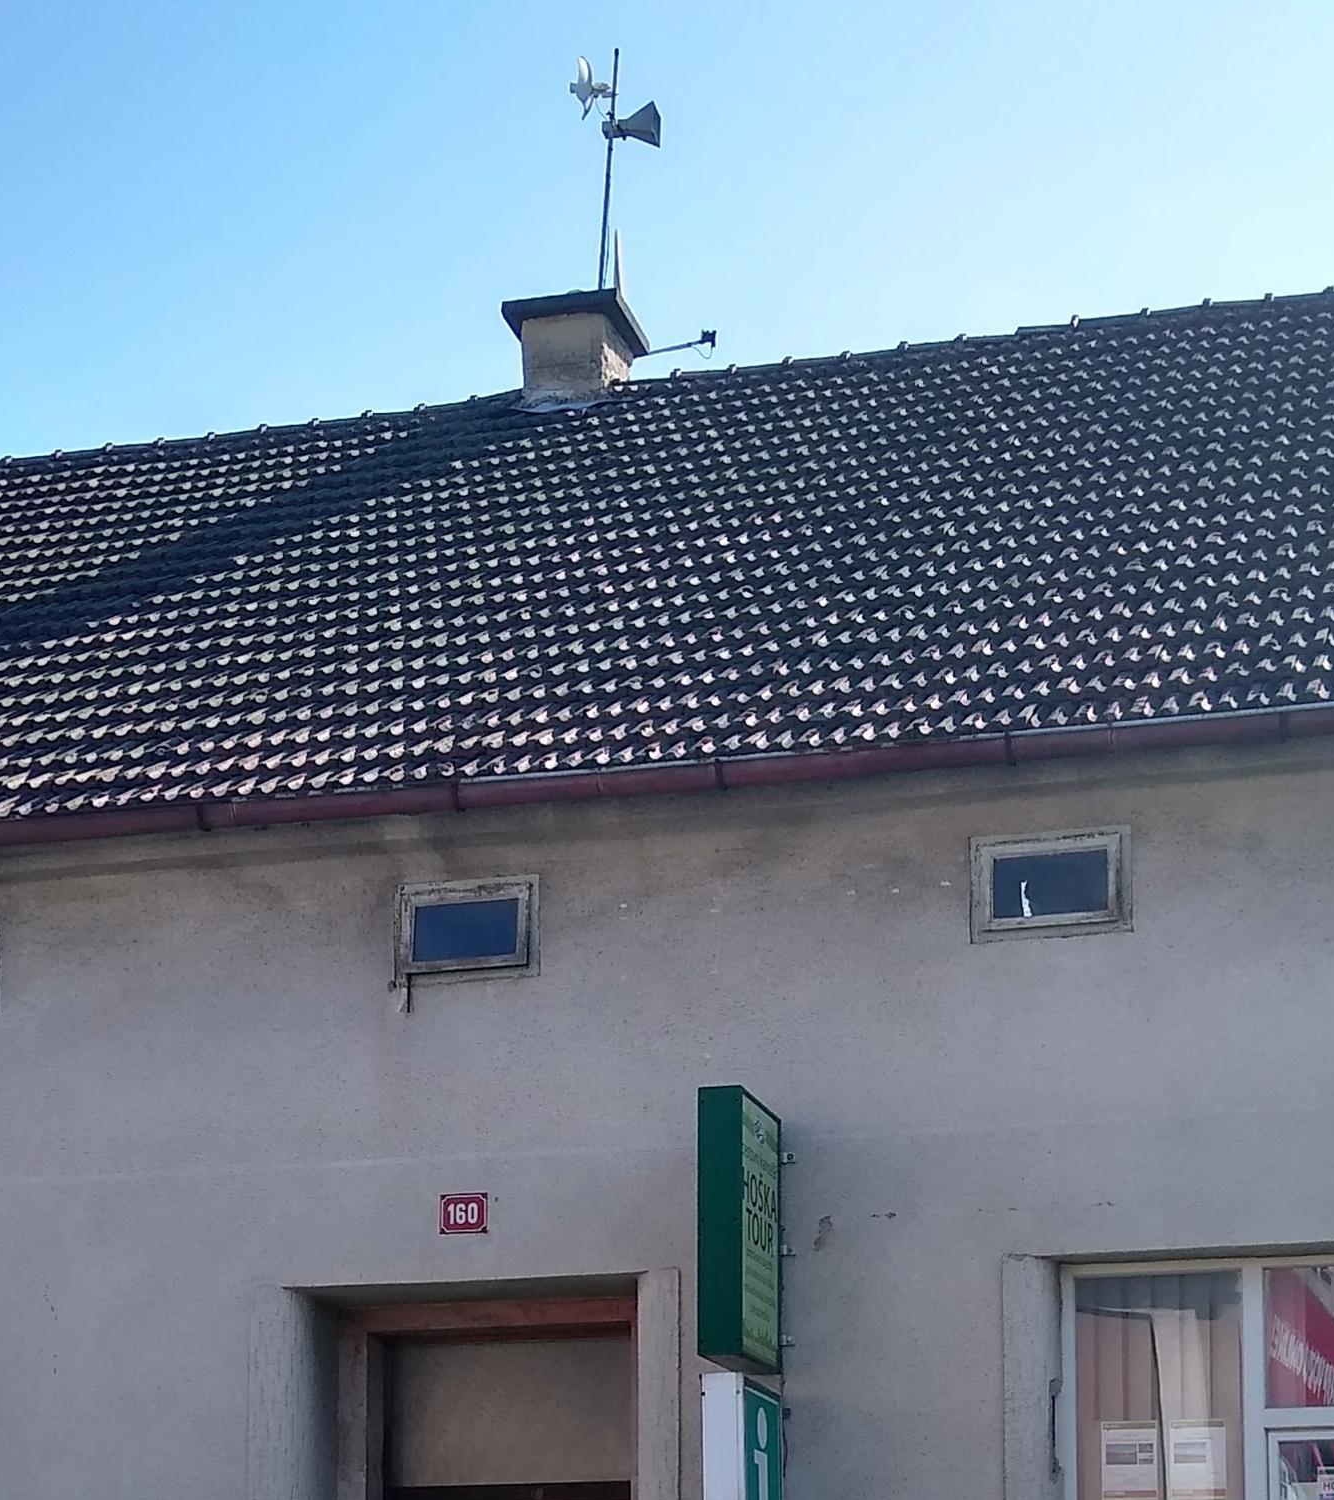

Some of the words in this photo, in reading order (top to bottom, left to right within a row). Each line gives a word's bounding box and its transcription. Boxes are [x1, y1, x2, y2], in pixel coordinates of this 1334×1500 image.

[447, 1202, 478, 1225] 160
[743, 1169, 777, 1223] HOŠKA
[746, 1207, 774, 1257] TOUR
